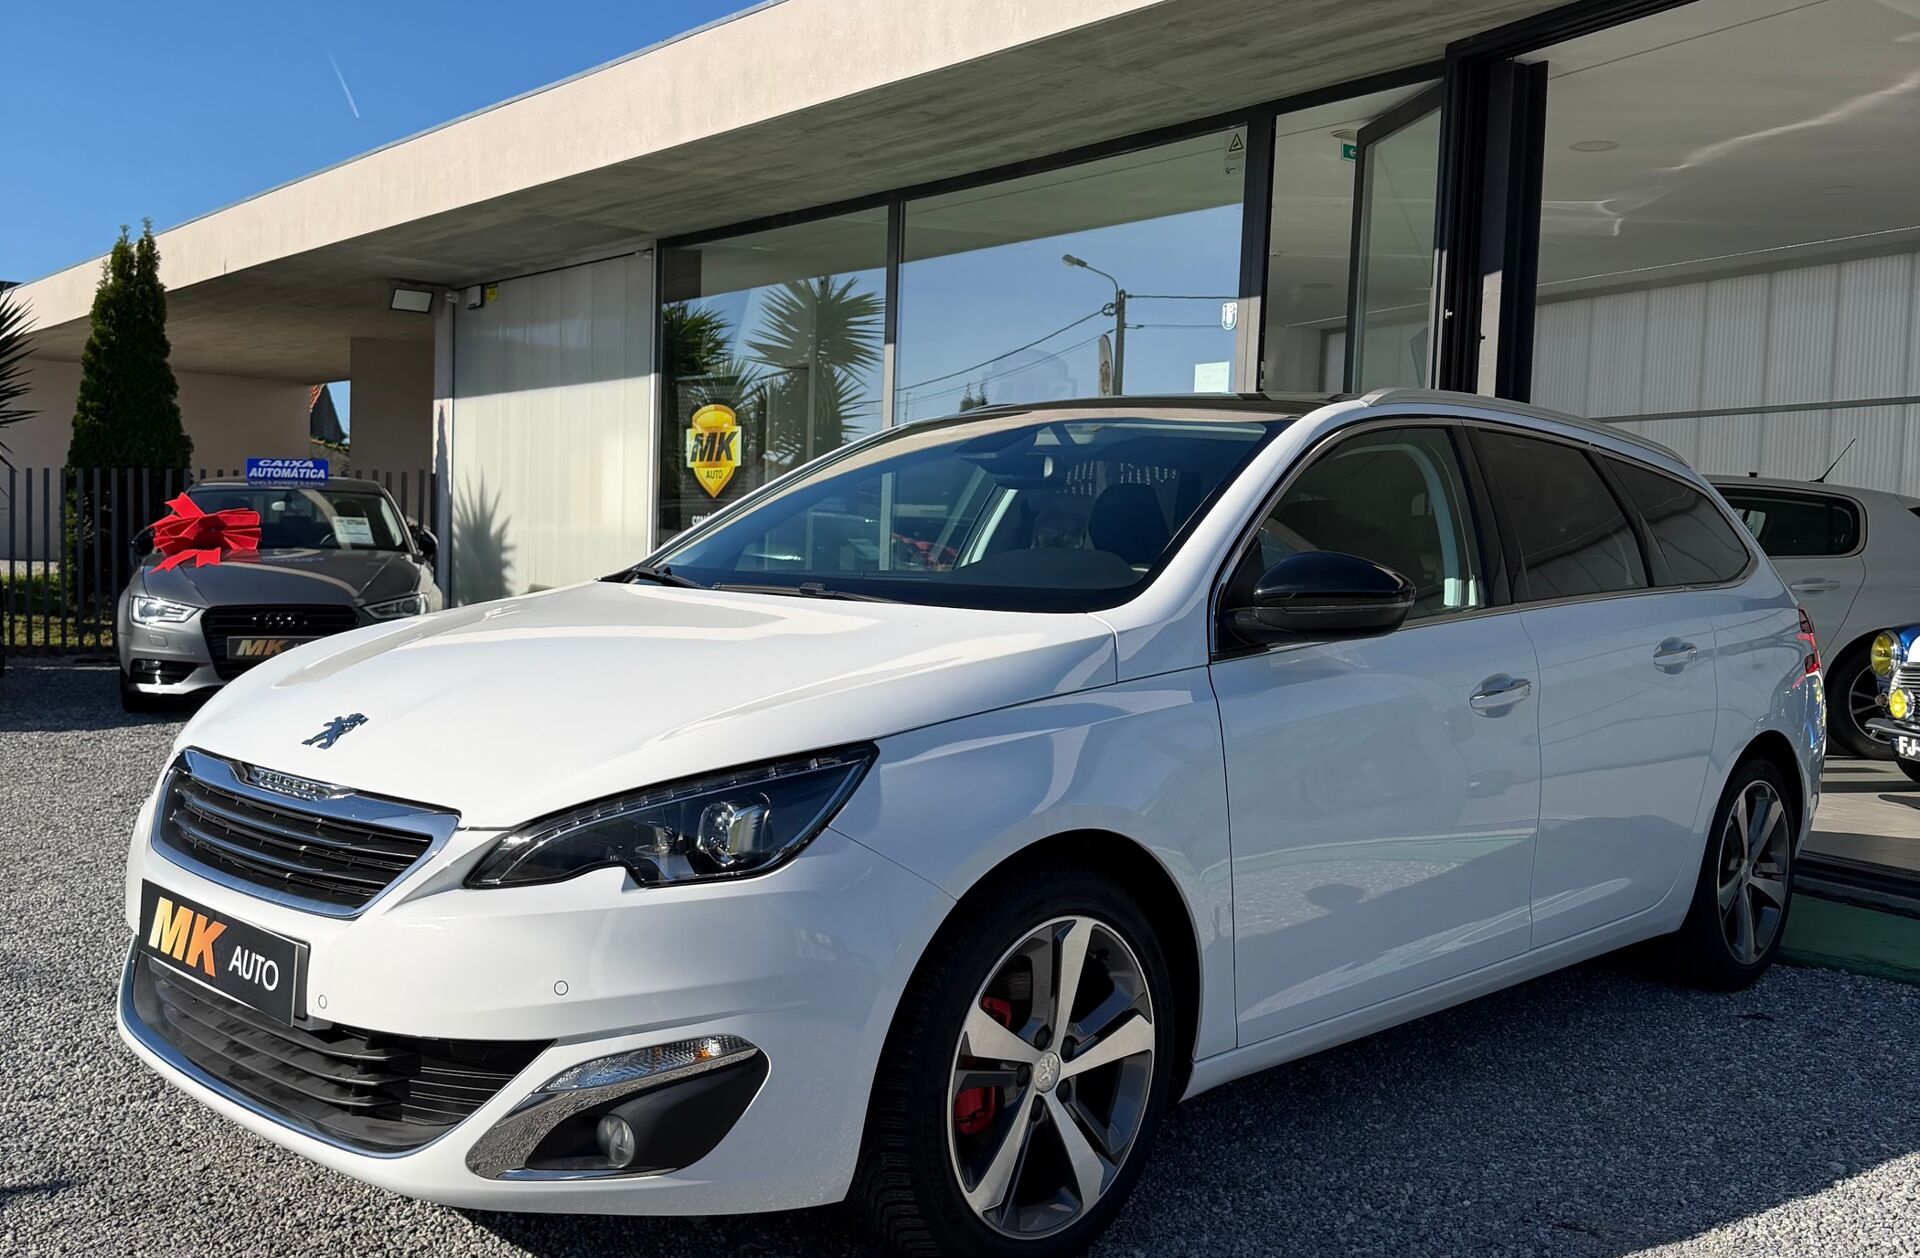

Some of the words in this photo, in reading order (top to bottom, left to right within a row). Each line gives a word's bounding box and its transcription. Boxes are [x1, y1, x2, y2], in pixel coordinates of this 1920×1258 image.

[690, 431, 738, 463] MK
[258, 459, 314, 467] CAIXA
[249, 466, 325, 479] AUTOMÁTICA
[705, 469, 723, 479] AUTO
[236, 639, 288, 656] MK
[258, 770, 317, 794] PEUGEOT
[148, 896, 228, 978] MK
[228, 945, 279, 992] AUTO
